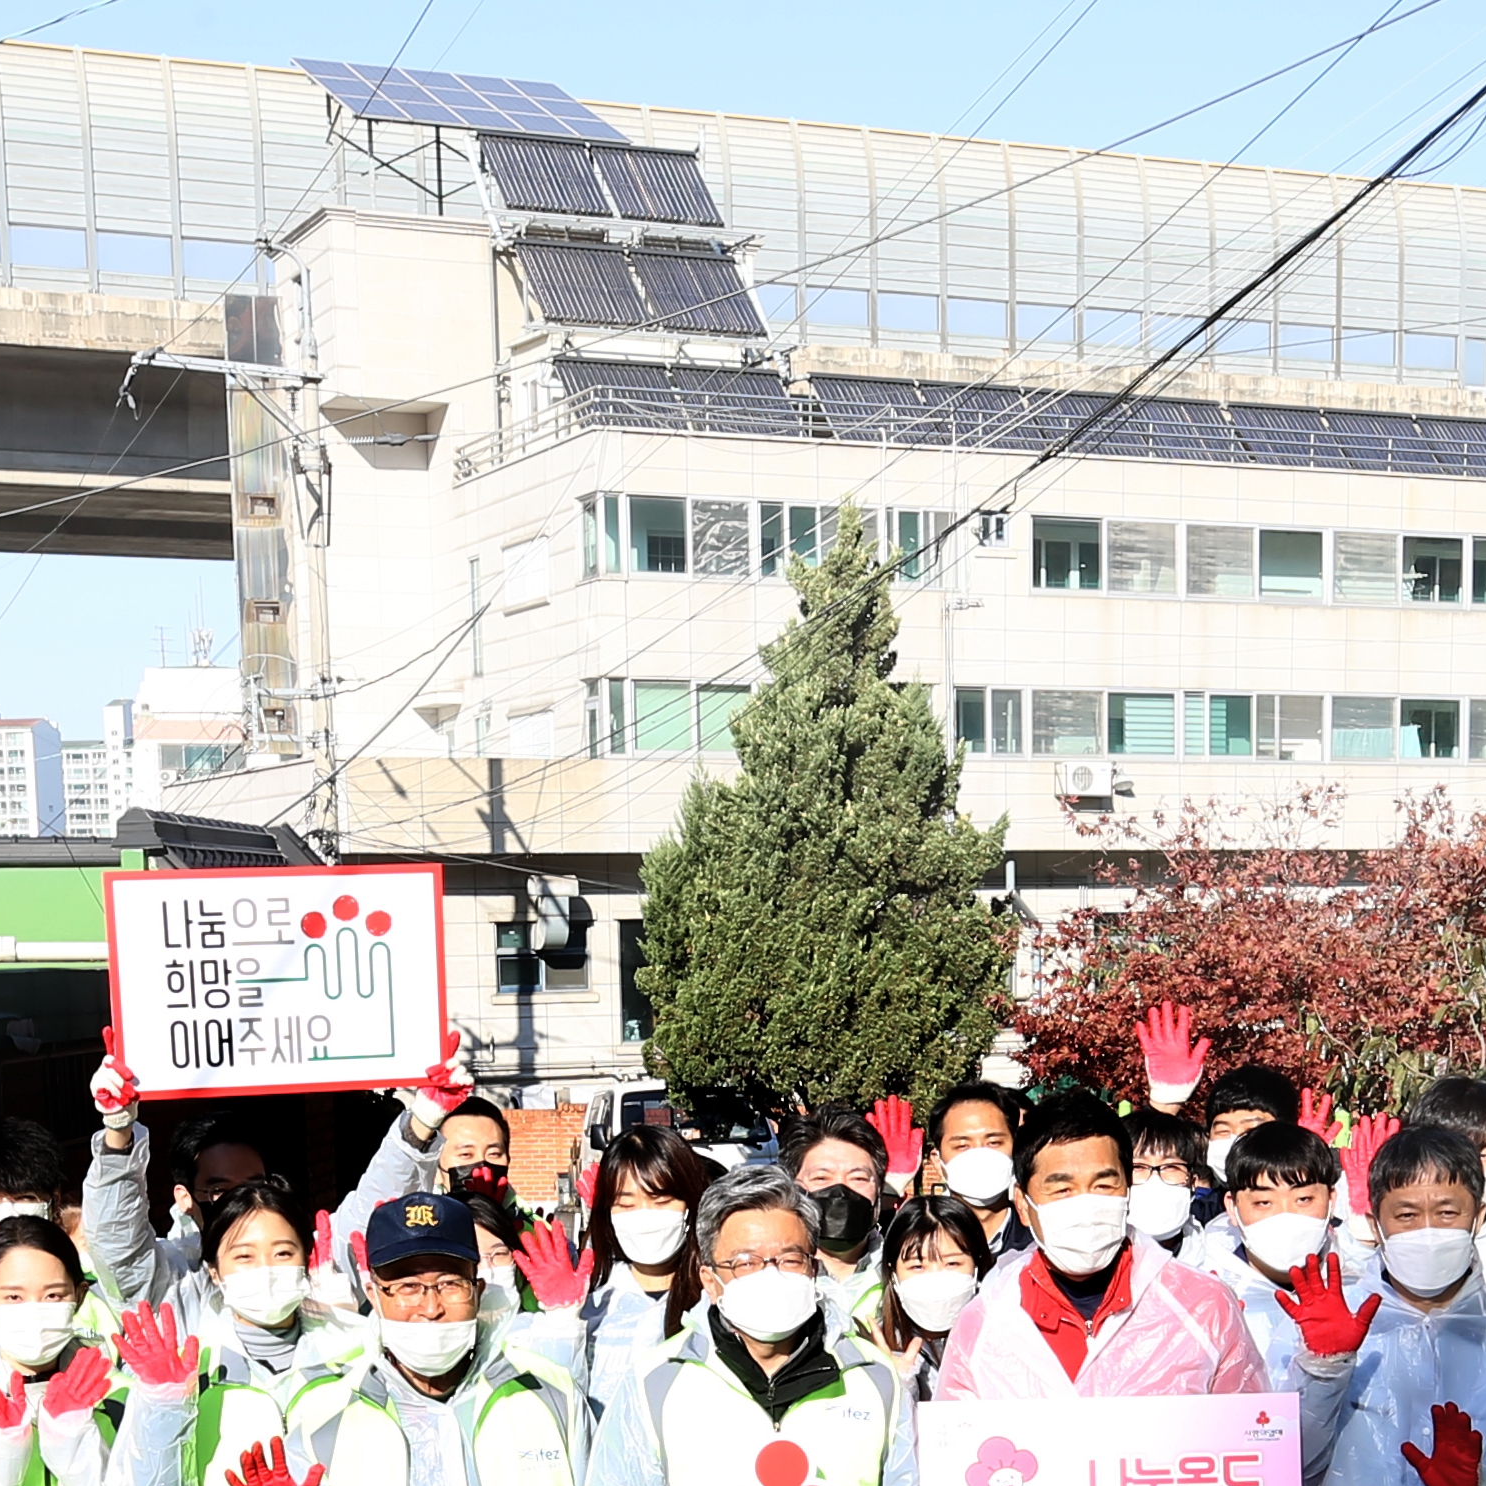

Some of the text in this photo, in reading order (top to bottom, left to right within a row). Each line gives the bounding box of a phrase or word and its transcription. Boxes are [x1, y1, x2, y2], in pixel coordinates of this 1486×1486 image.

[162, 897, 295, 949] 나눔으로
[165, 957, 264, 1009] 희망을
[170, 1014, 332, 1069] 이어주세요
